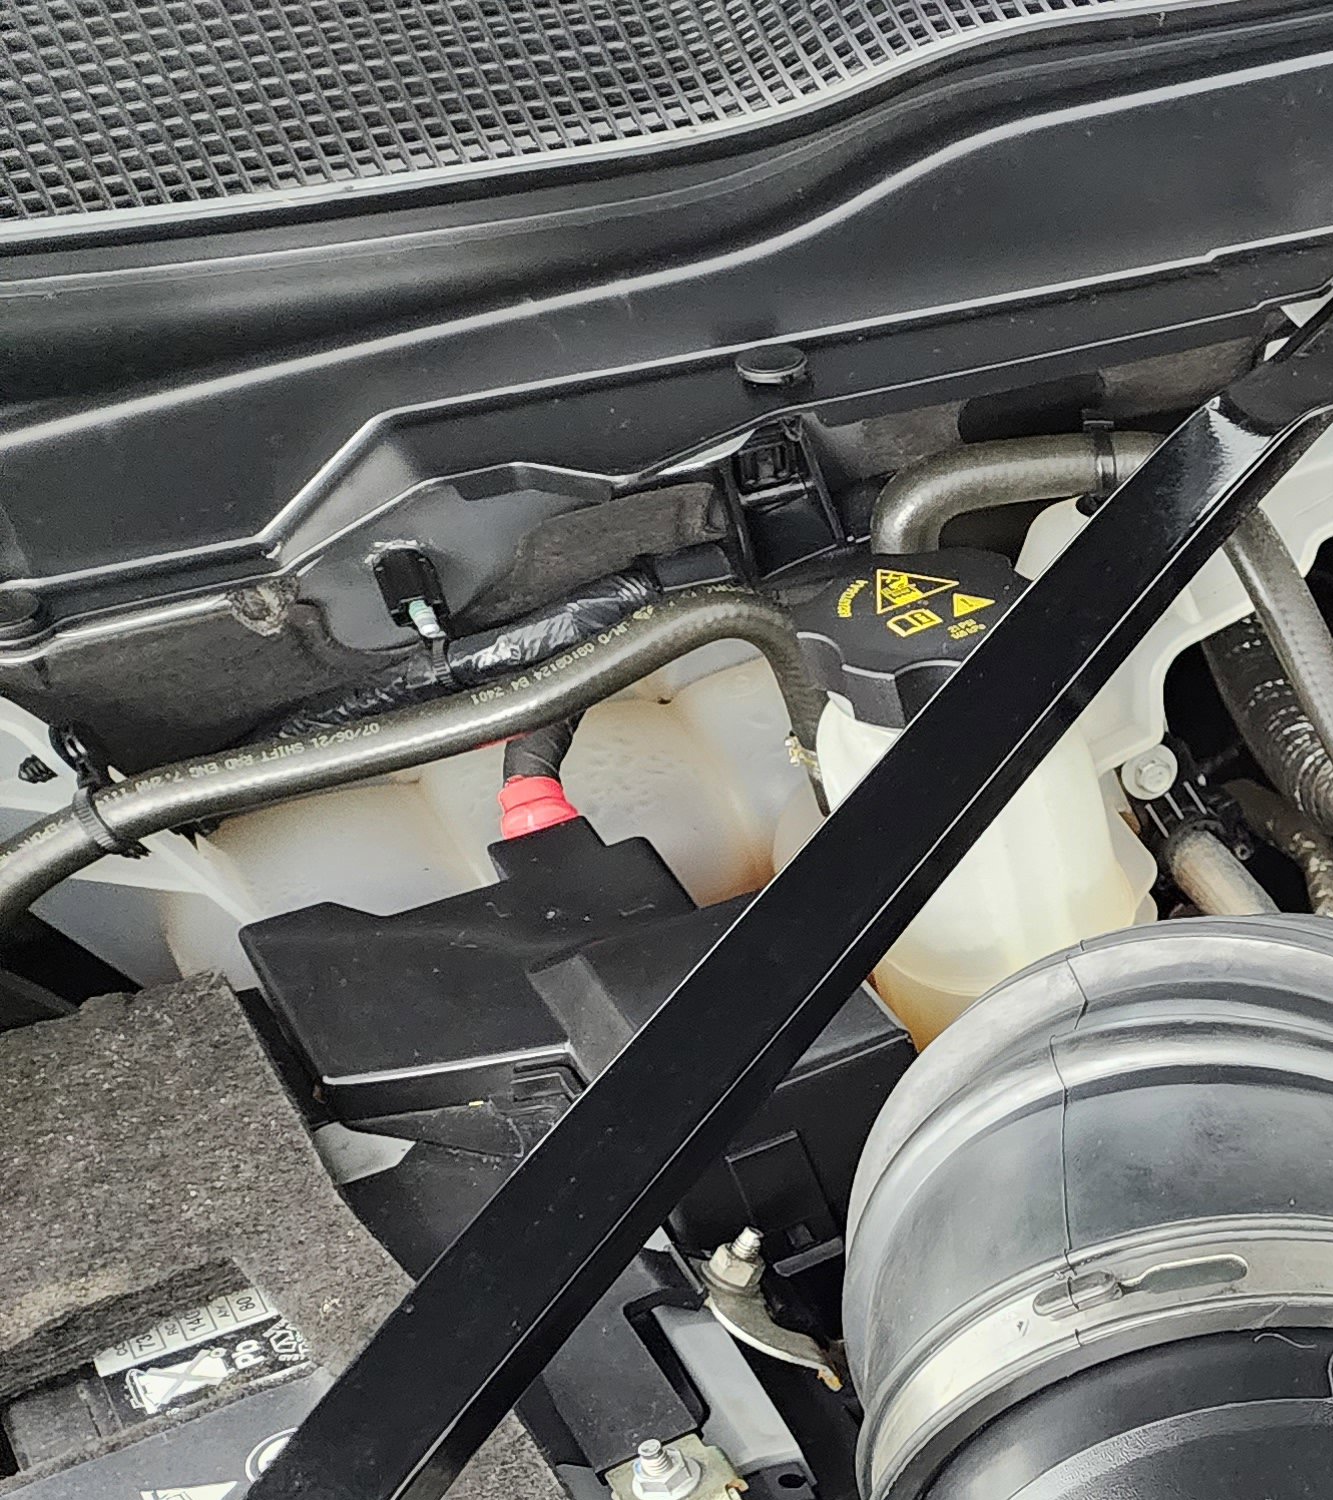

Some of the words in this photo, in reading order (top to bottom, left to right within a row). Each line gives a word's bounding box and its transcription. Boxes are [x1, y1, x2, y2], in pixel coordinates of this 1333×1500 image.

[311, 722, 381, 750] 07/06/21
[260, 741, 304, 764] SHIFT
[190, 761, 219, 779] ENG
[235, 1296, 256, 1312] 80
[234, 1339, 265, 1370] Pb
